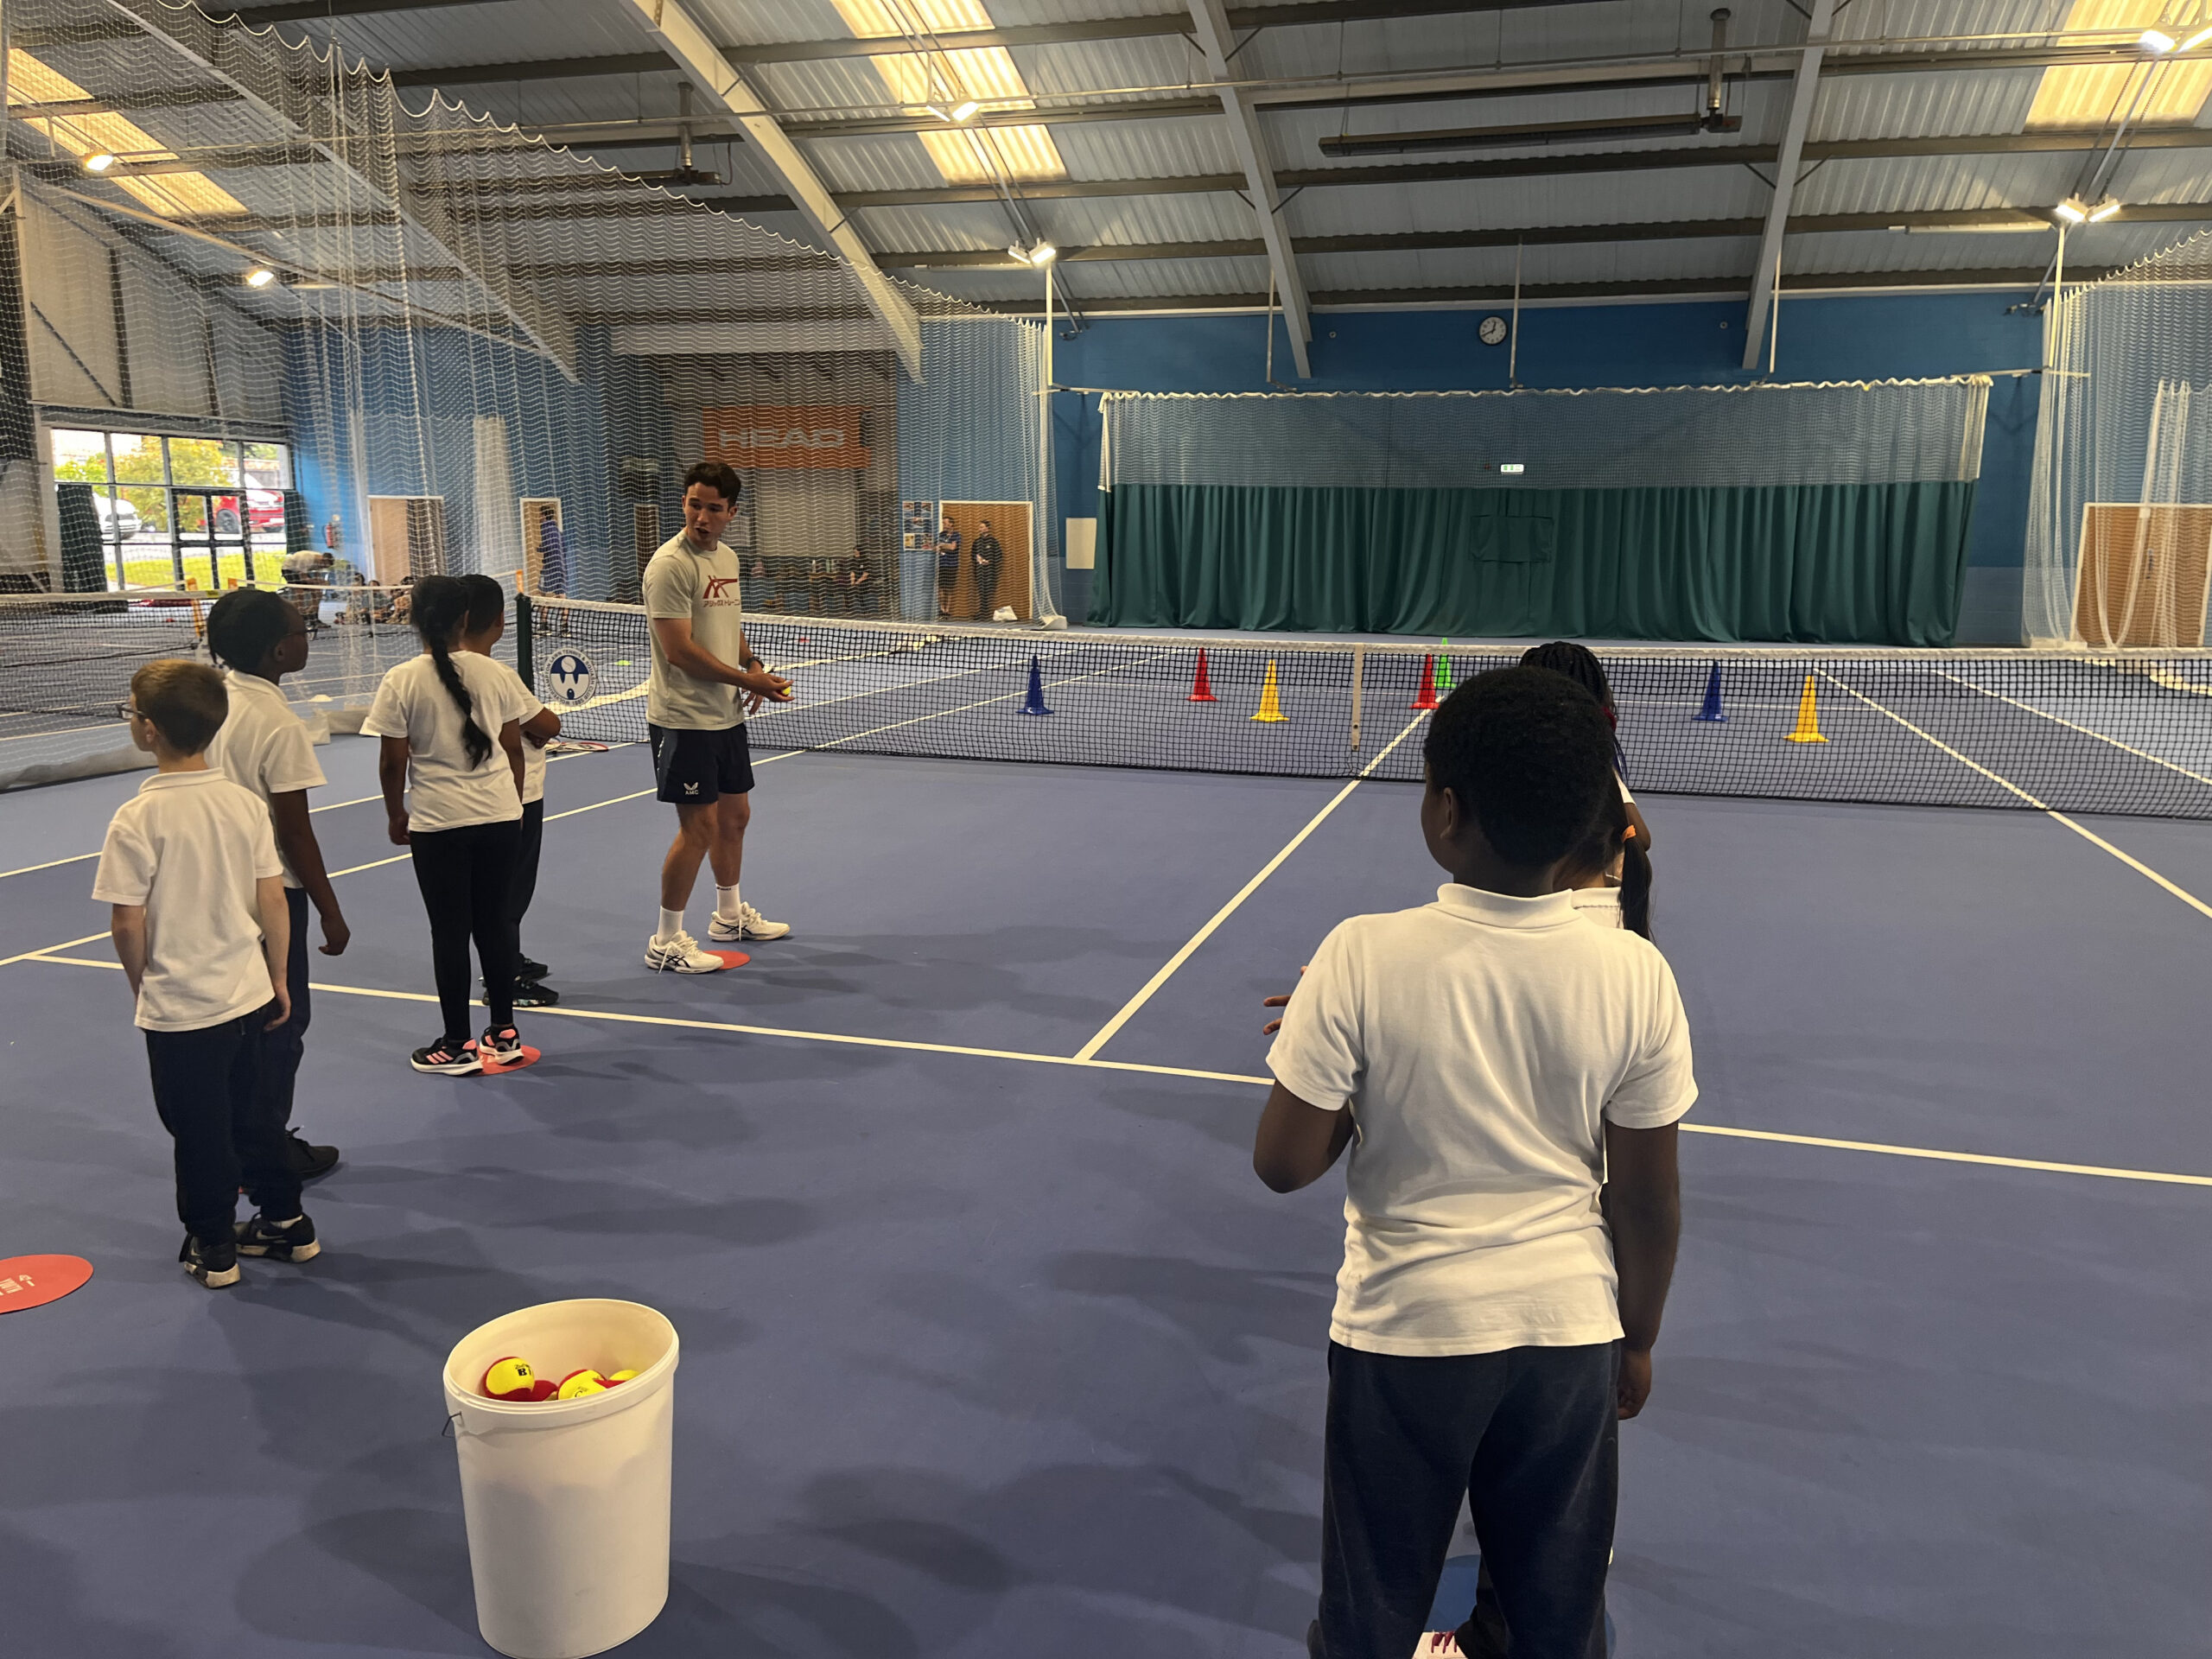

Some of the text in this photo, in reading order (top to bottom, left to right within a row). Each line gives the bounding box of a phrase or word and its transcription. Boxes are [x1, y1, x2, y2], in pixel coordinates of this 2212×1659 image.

[719, 427, 844, 448] HEAD
[586, 661, 594, 684] SQUASH
[584, 685, 594, 700] CLUB
